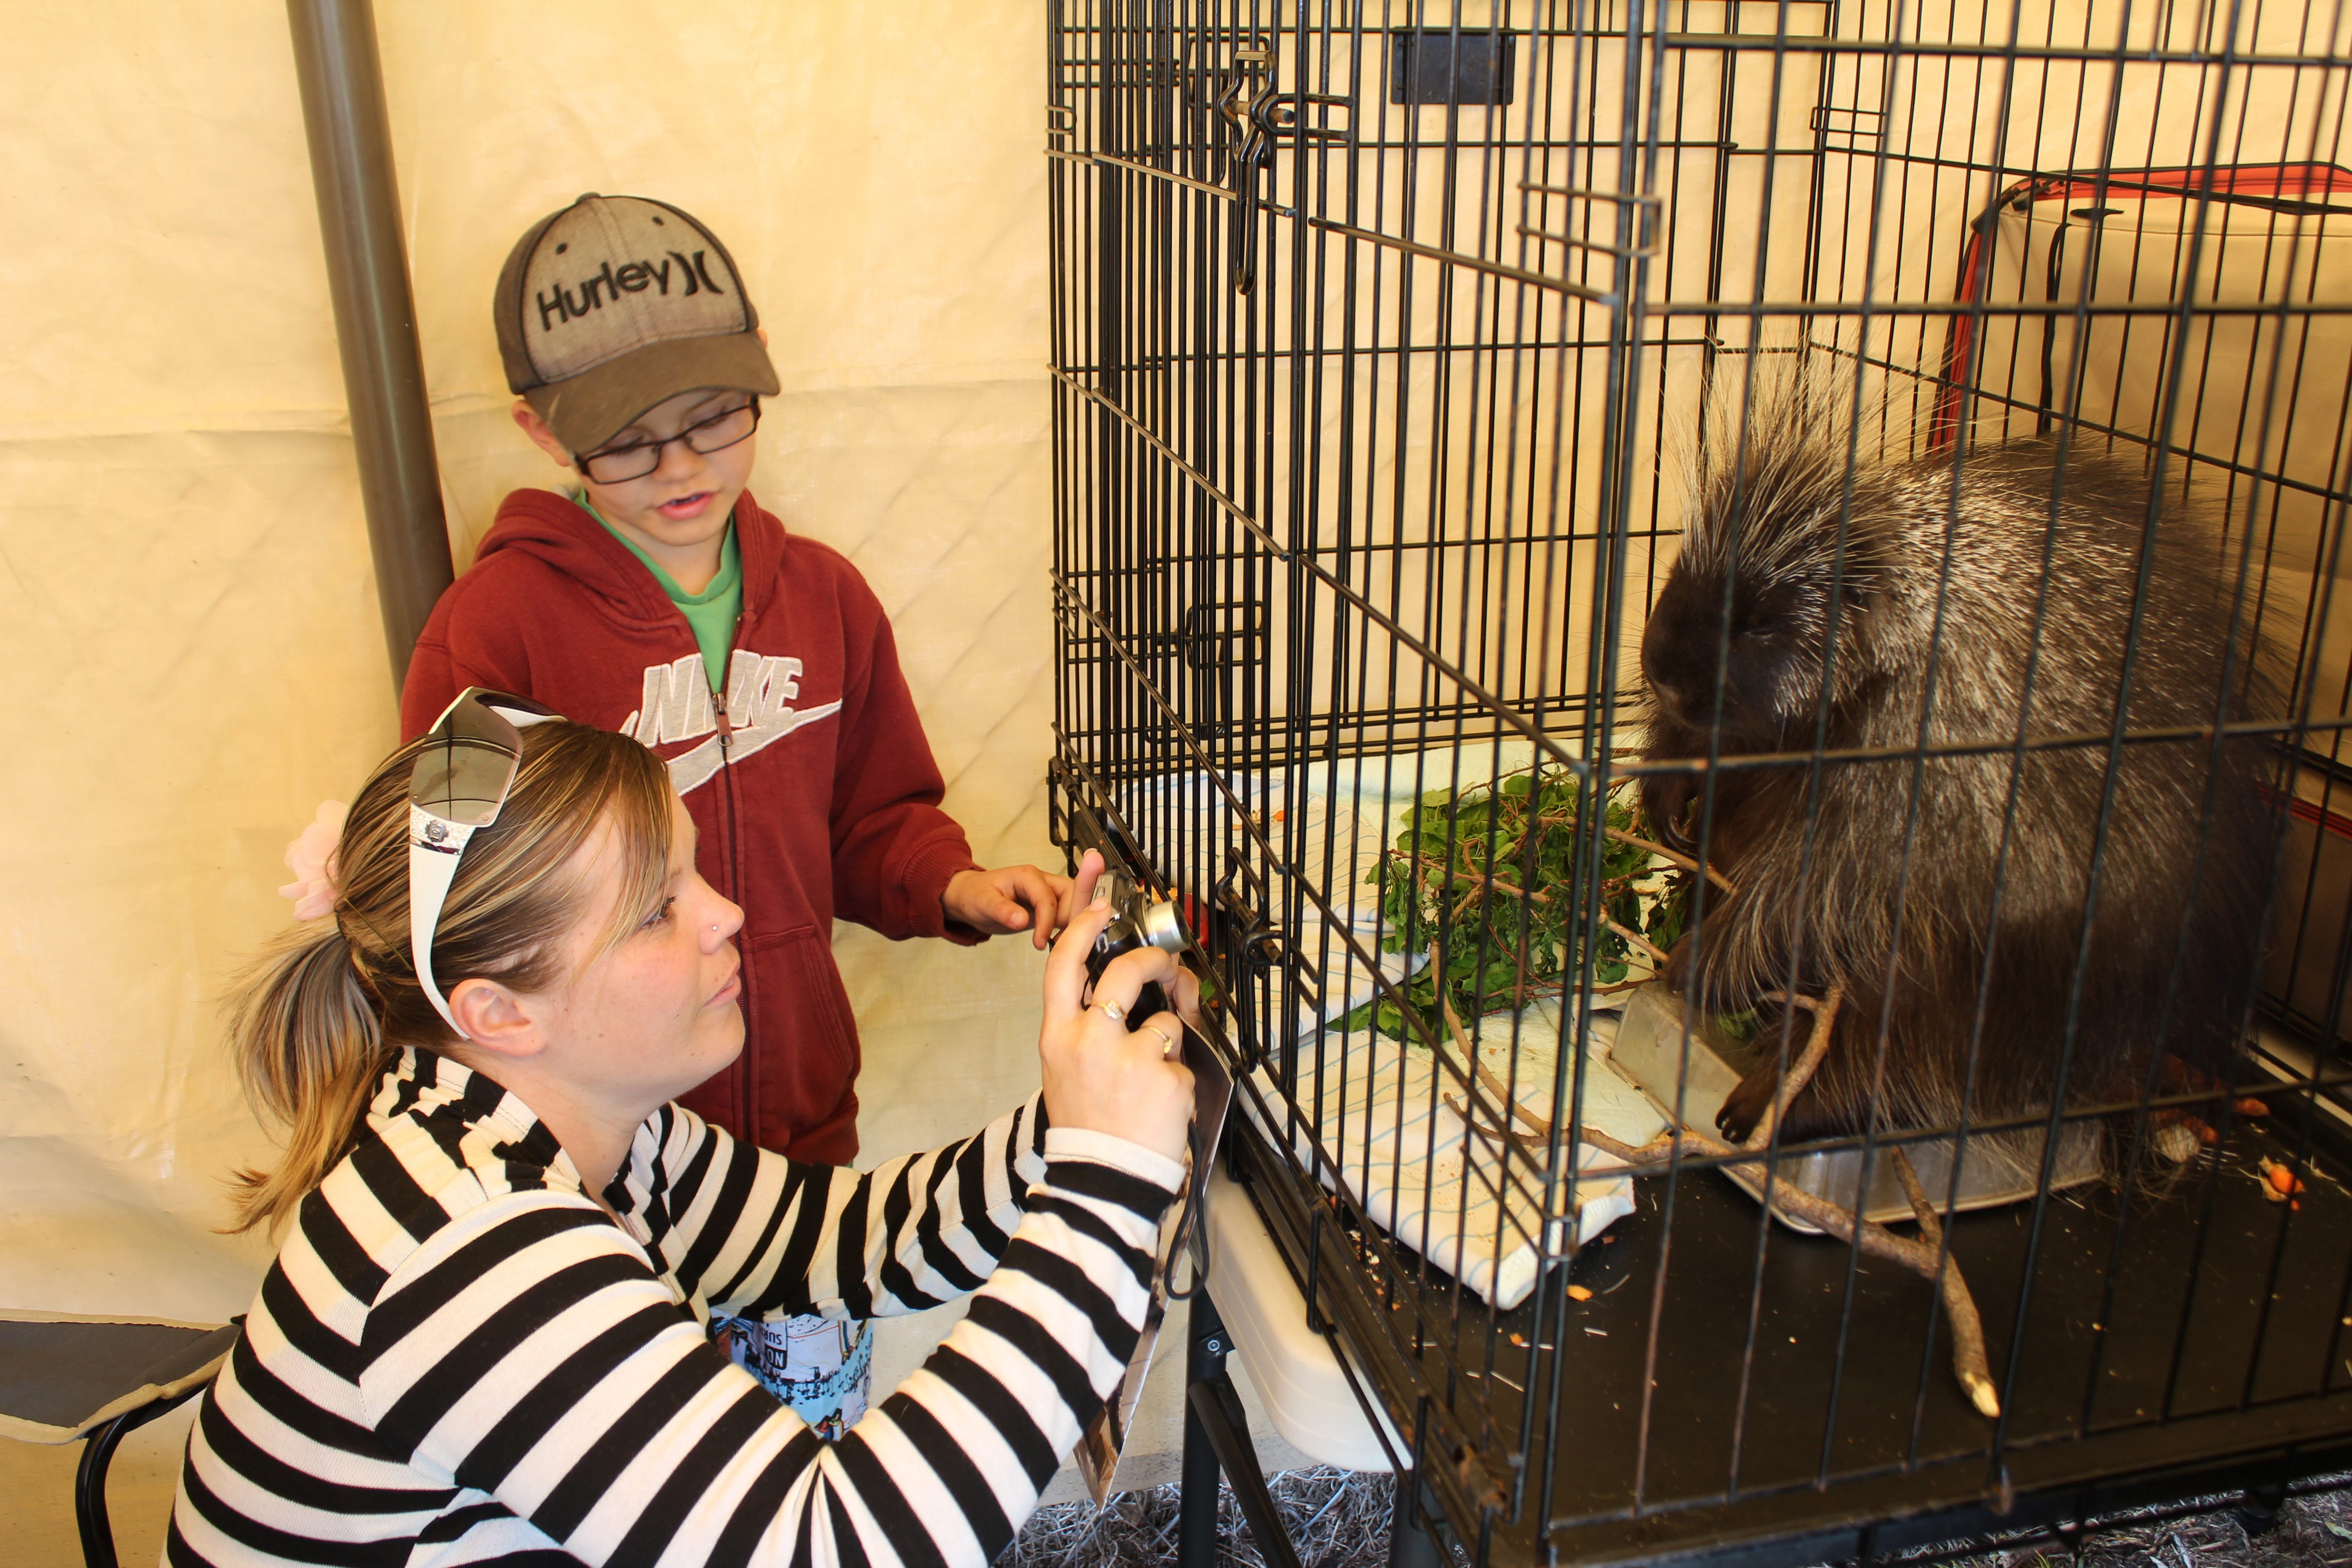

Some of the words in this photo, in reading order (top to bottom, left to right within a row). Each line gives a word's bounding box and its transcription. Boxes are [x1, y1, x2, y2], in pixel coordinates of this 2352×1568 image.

[537, 258, 670, 332] Hurley
[635, 650, 802, 747] NIKE
[767, 1348, 784, 1367] NO
